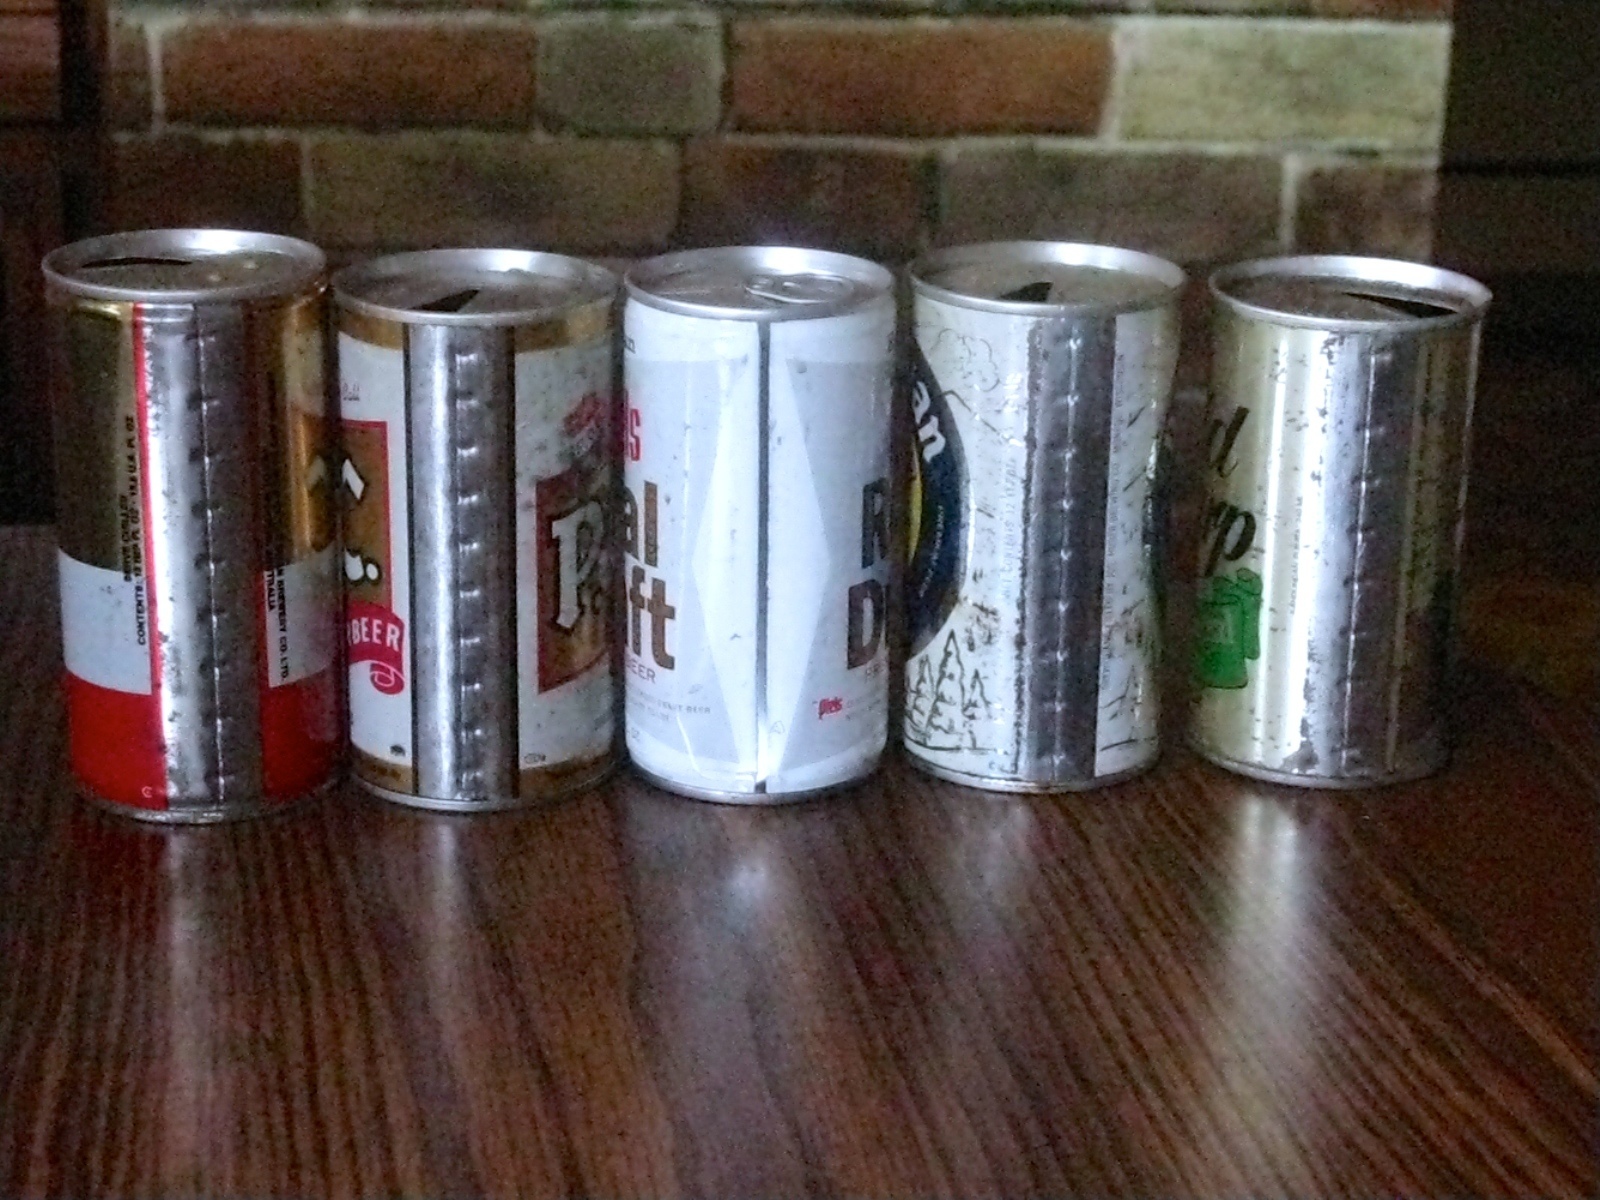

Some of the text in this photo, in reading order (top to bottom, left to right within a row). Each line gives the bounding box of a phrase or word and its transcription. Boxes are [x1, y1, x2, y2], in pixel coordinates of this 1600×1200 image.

[911, 380, 947, 464] an
[624, 480, 659, 568] al
[351, 616, 402, 651] BEER
[629, 565, 676, 670] ft
